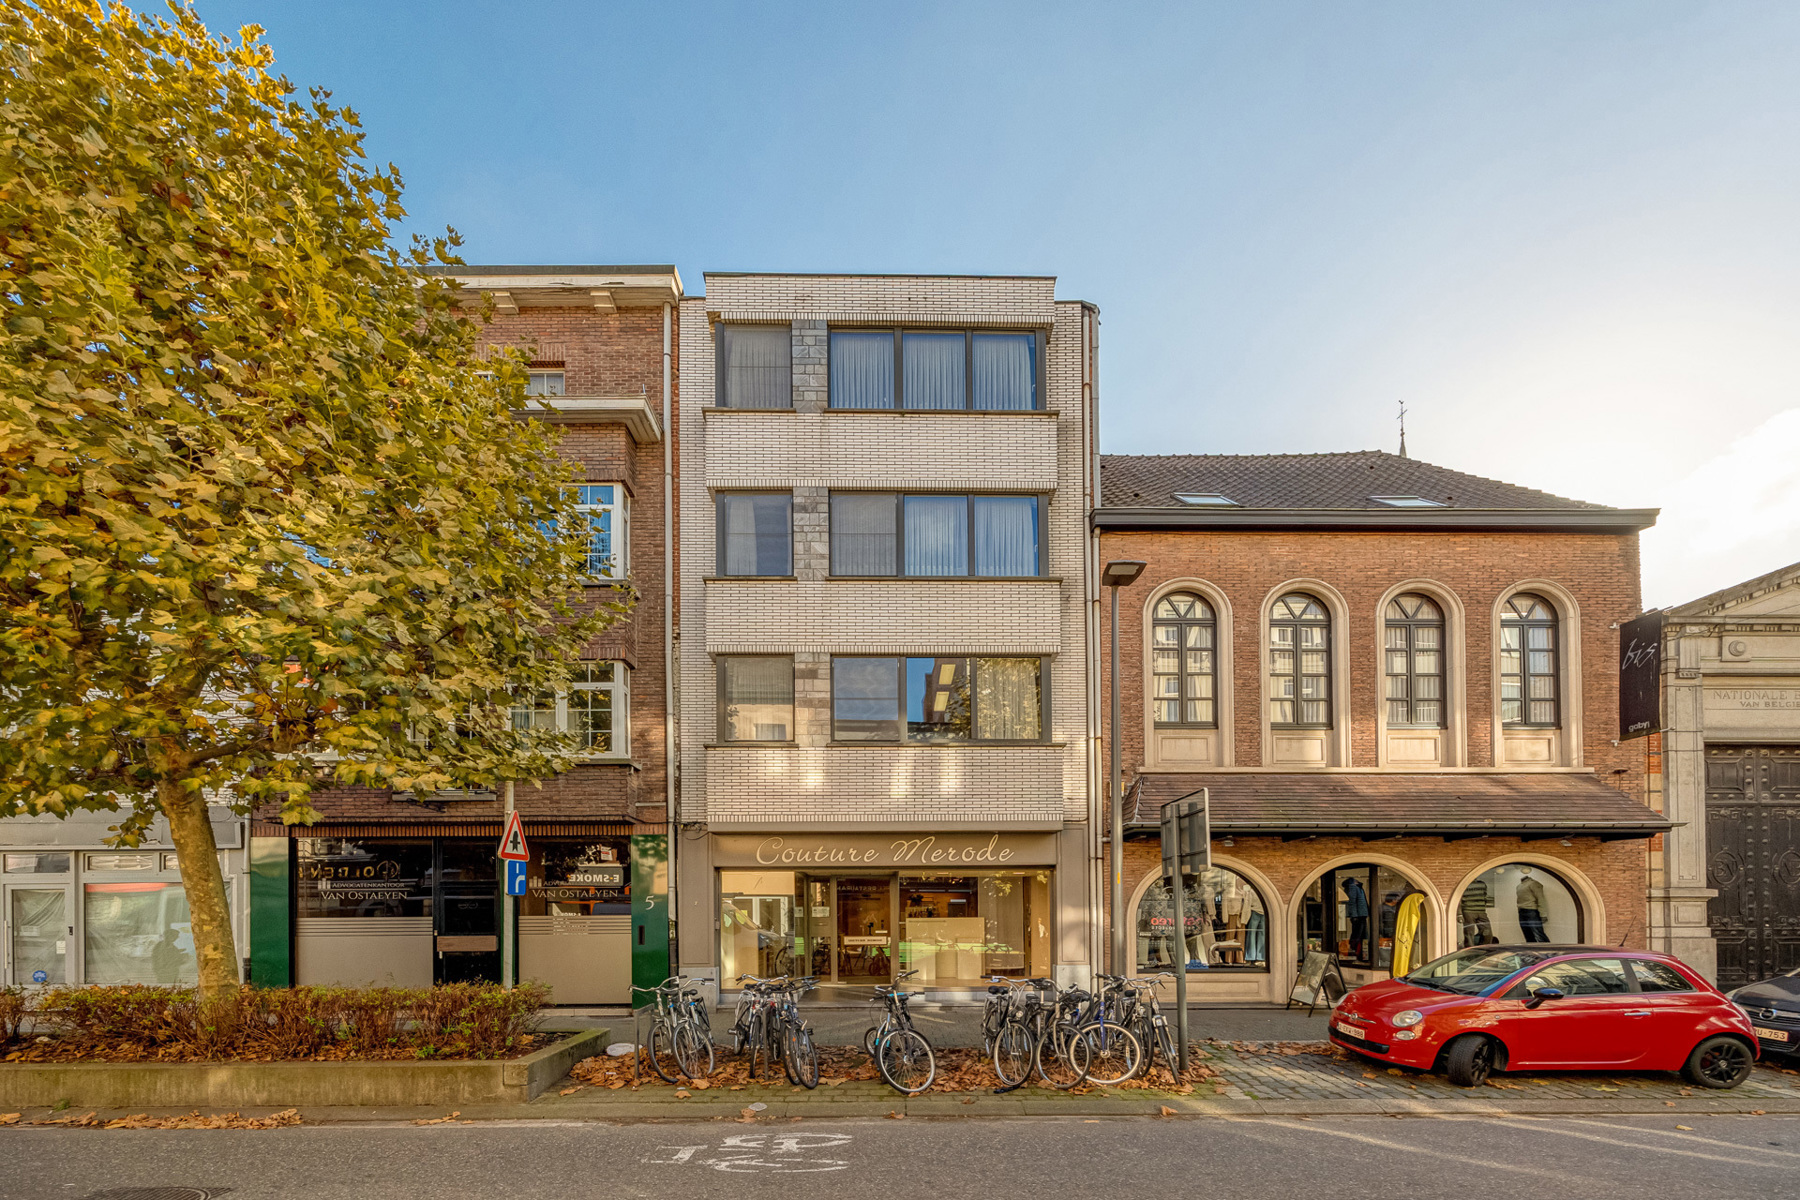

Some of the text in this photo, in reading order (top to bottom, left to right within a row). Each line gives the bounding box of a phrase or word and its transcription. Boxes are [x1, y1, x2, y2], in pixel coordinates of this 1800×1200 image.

[1713, 690, 1788, 700] NATIONALE
[756, 834, 1015, 865] Couture Merode
[321, 891, 408, 900] VAN OSTAEYEN
[532, 889, 556, 898] VAN
[645, 895, 655, 910] 5
